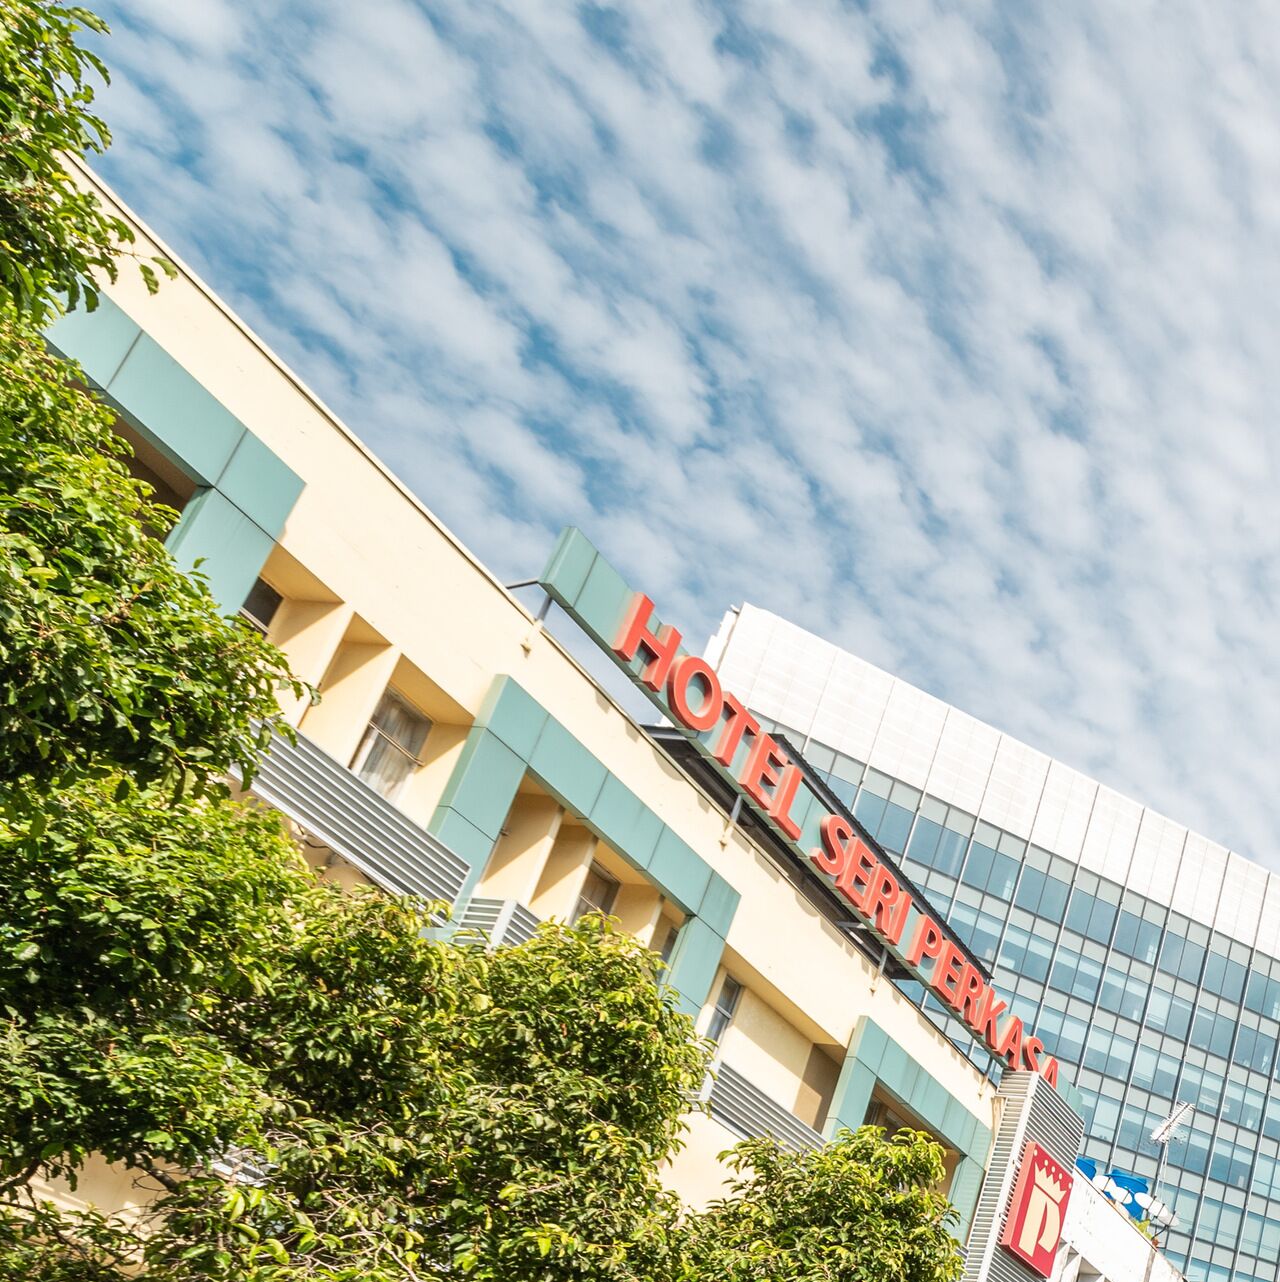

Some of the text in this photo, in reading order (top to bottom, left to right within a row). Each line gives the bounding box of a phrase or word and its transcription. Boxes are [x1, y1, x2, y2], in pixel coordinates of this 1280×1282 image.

[612, 592, 1060, 1090] HOTEL SERI PERKASA
